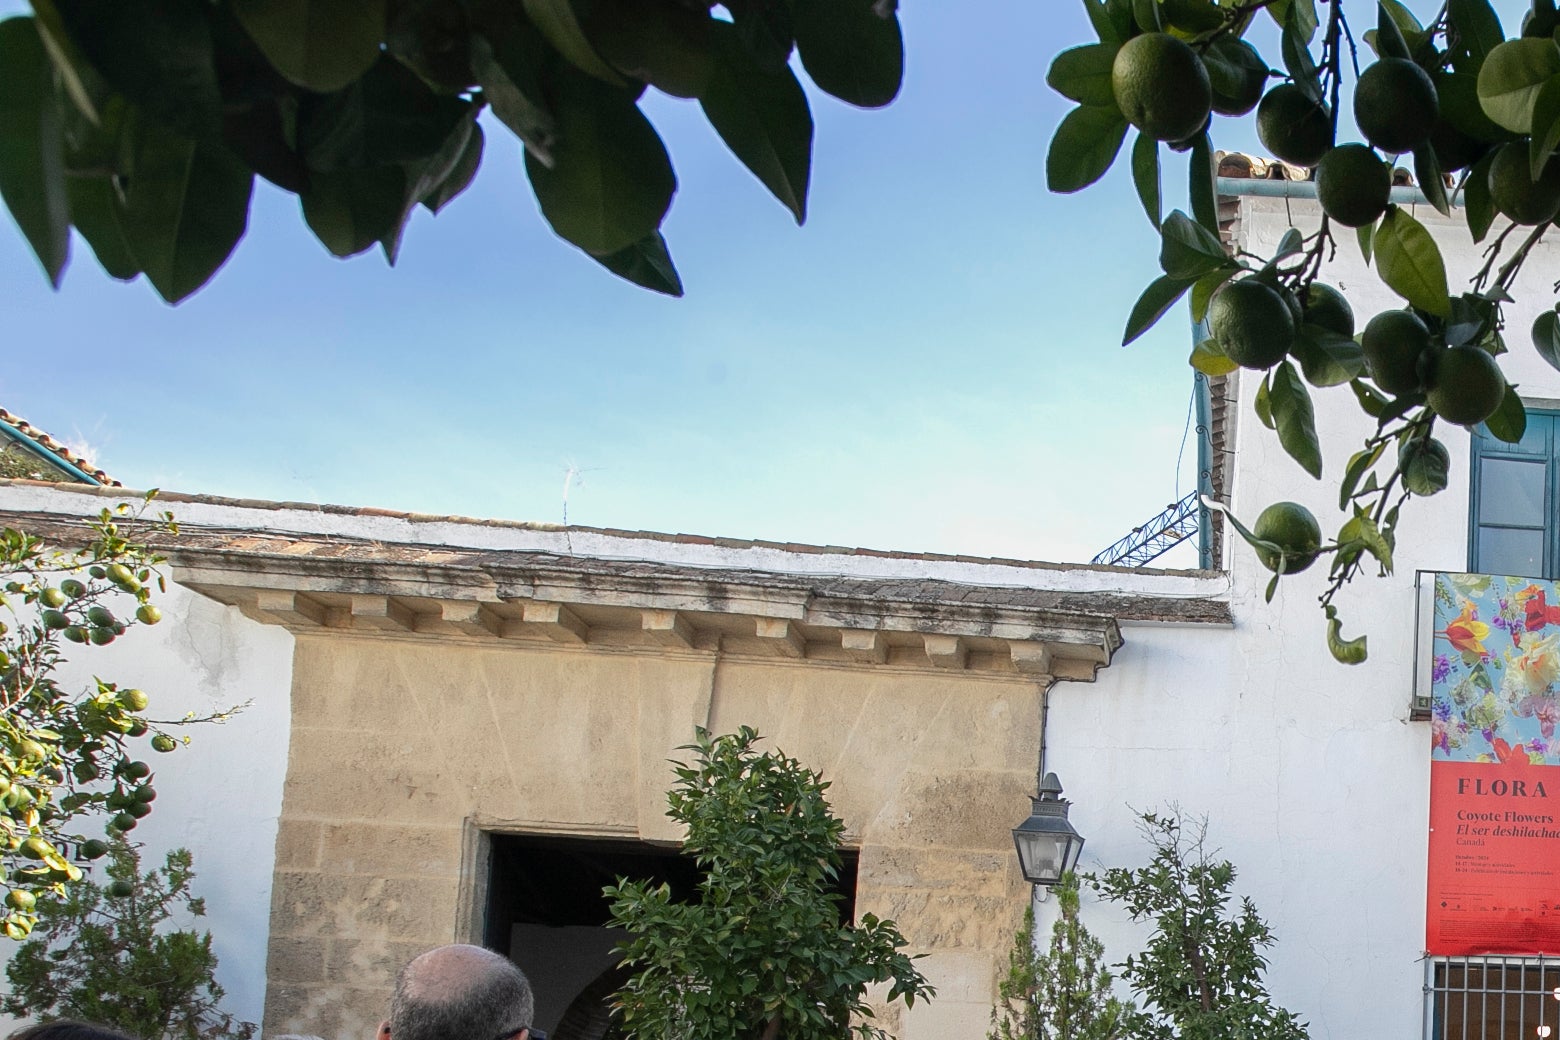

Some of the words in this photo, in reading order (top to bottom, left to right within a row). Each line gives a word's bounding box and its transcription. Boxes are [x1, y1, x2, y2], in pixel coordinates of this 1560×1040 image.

[1457, 777, 1548, 798] FLORA
[1456, 809, 1501, 824] Coyote
[1504, 811, 1554, 824] Flowers
[1456, 824, 1469, 835] El
[1472, 826, 1490, 836] ser
[1456, 837, 1485, 847] Canadá
